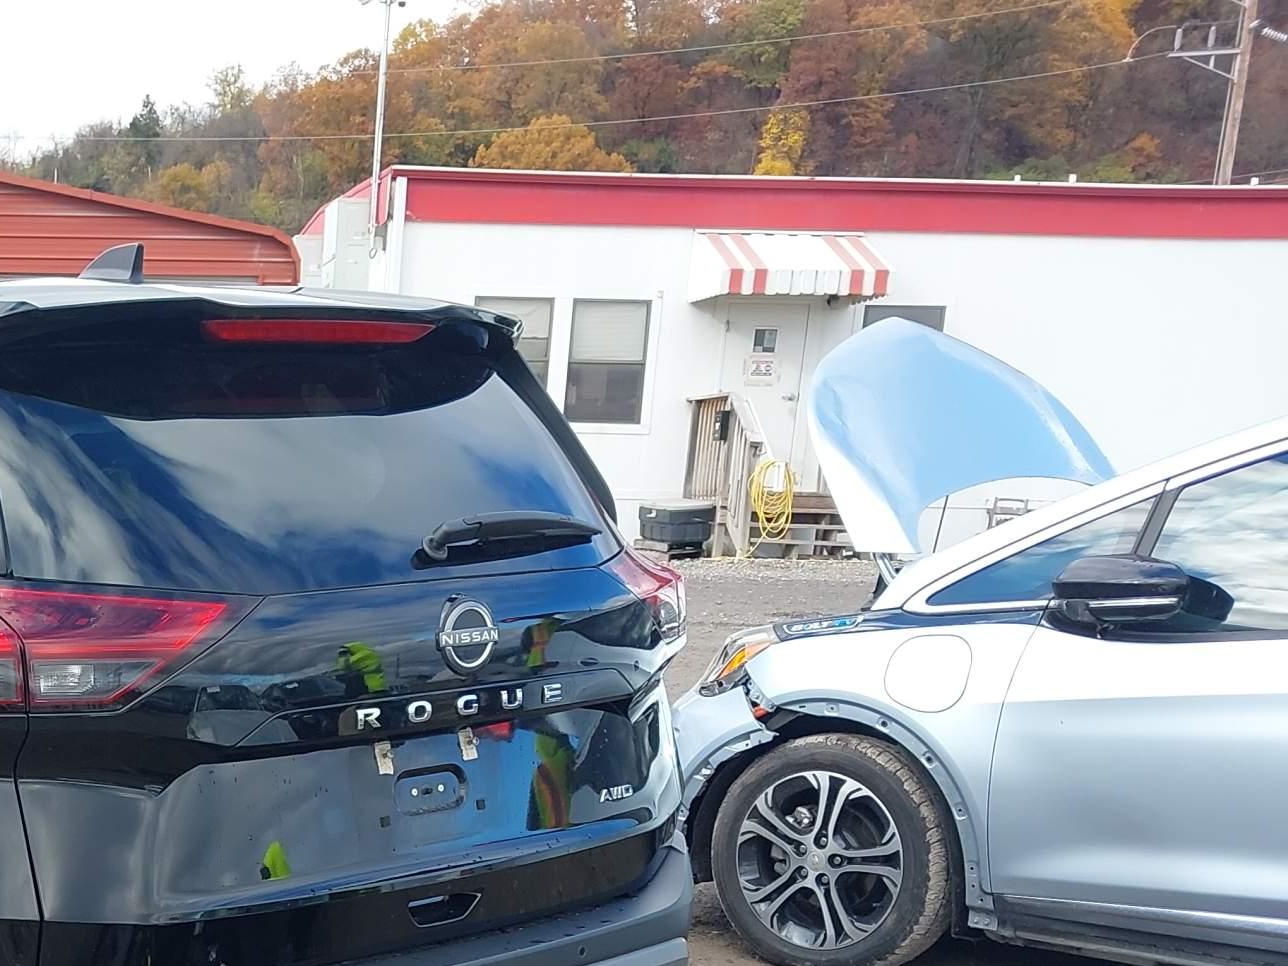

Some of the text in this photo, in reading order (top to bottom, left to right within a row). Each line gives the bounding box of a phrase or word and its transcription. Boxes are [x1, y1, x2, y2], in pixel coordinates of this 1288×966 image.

[441, 629, 499, 645] NISSAN
[355, 682, 563, 730] ROGUE
[599, 784, 633, 803] AWD
